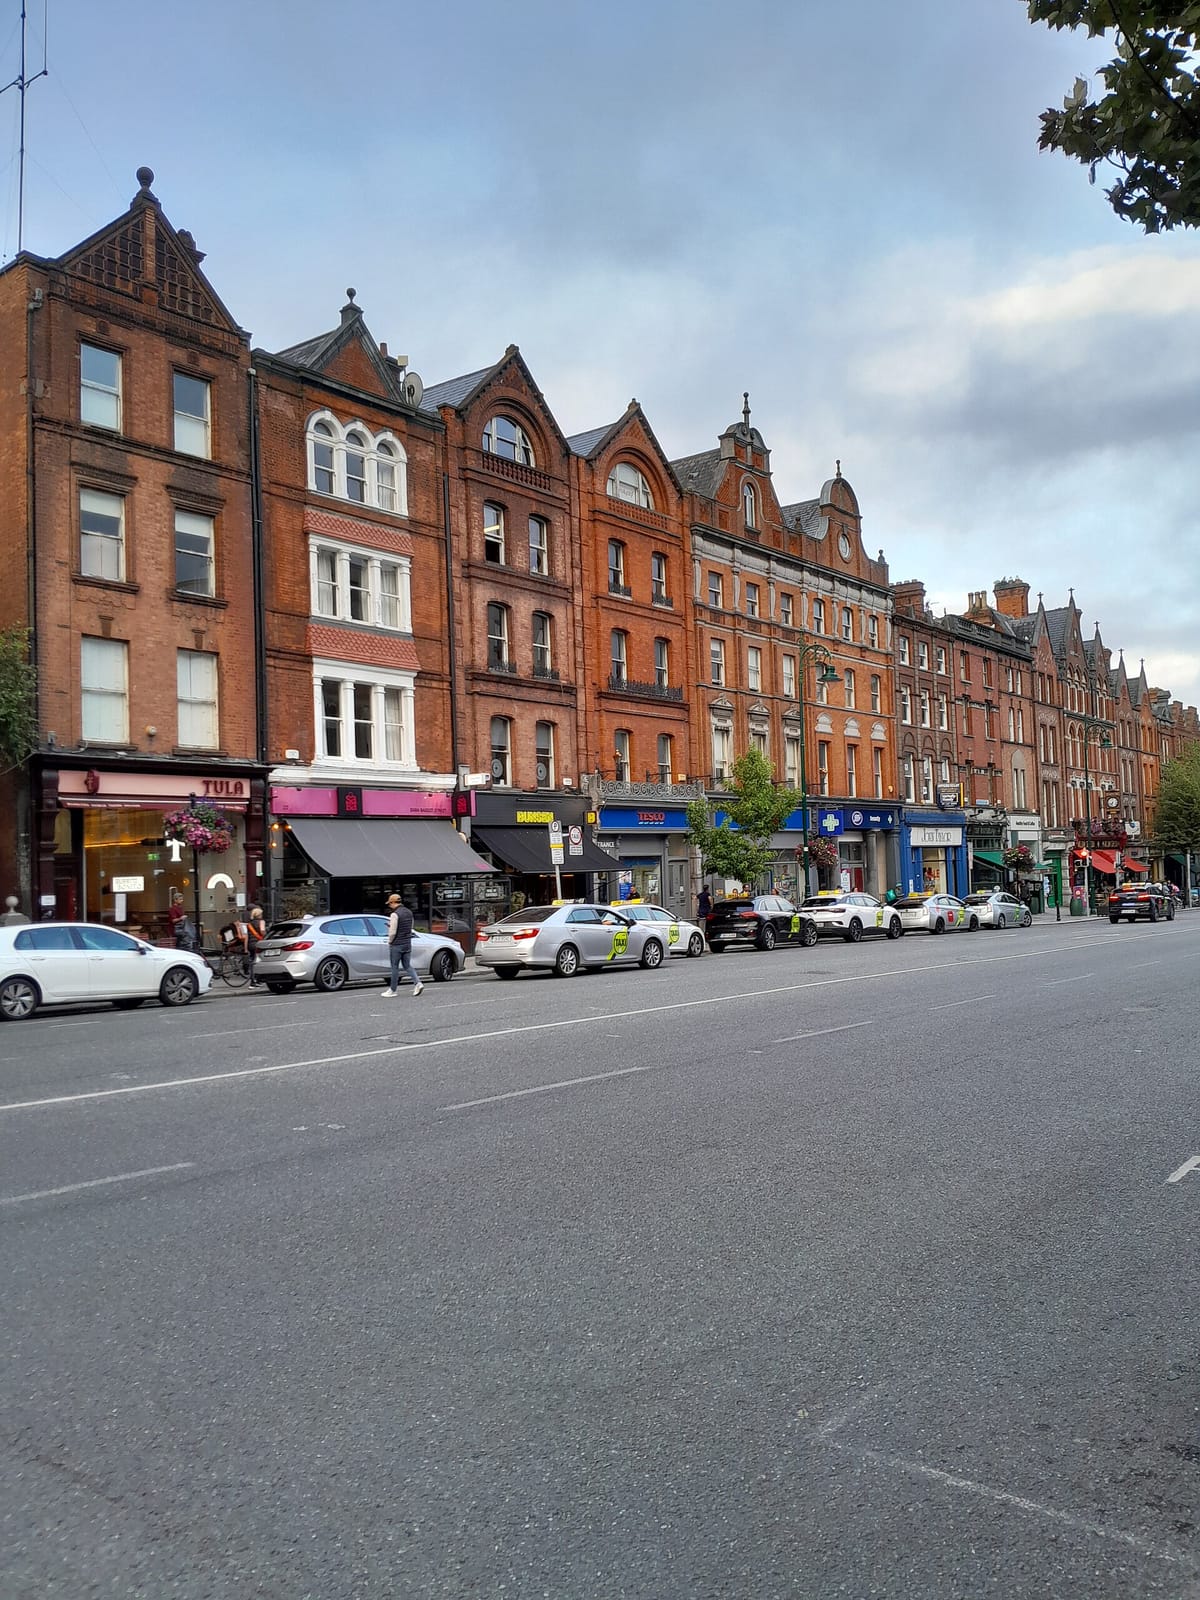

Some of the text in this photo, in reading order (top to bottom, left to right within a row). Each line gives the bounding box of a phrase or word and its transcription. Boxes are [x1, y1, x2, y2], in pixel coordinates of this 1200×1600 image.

[202, 779, 245, 795] TULA
[637, 812, 665, 821] TESCO
[615, 938, 626, 947] TAXI
